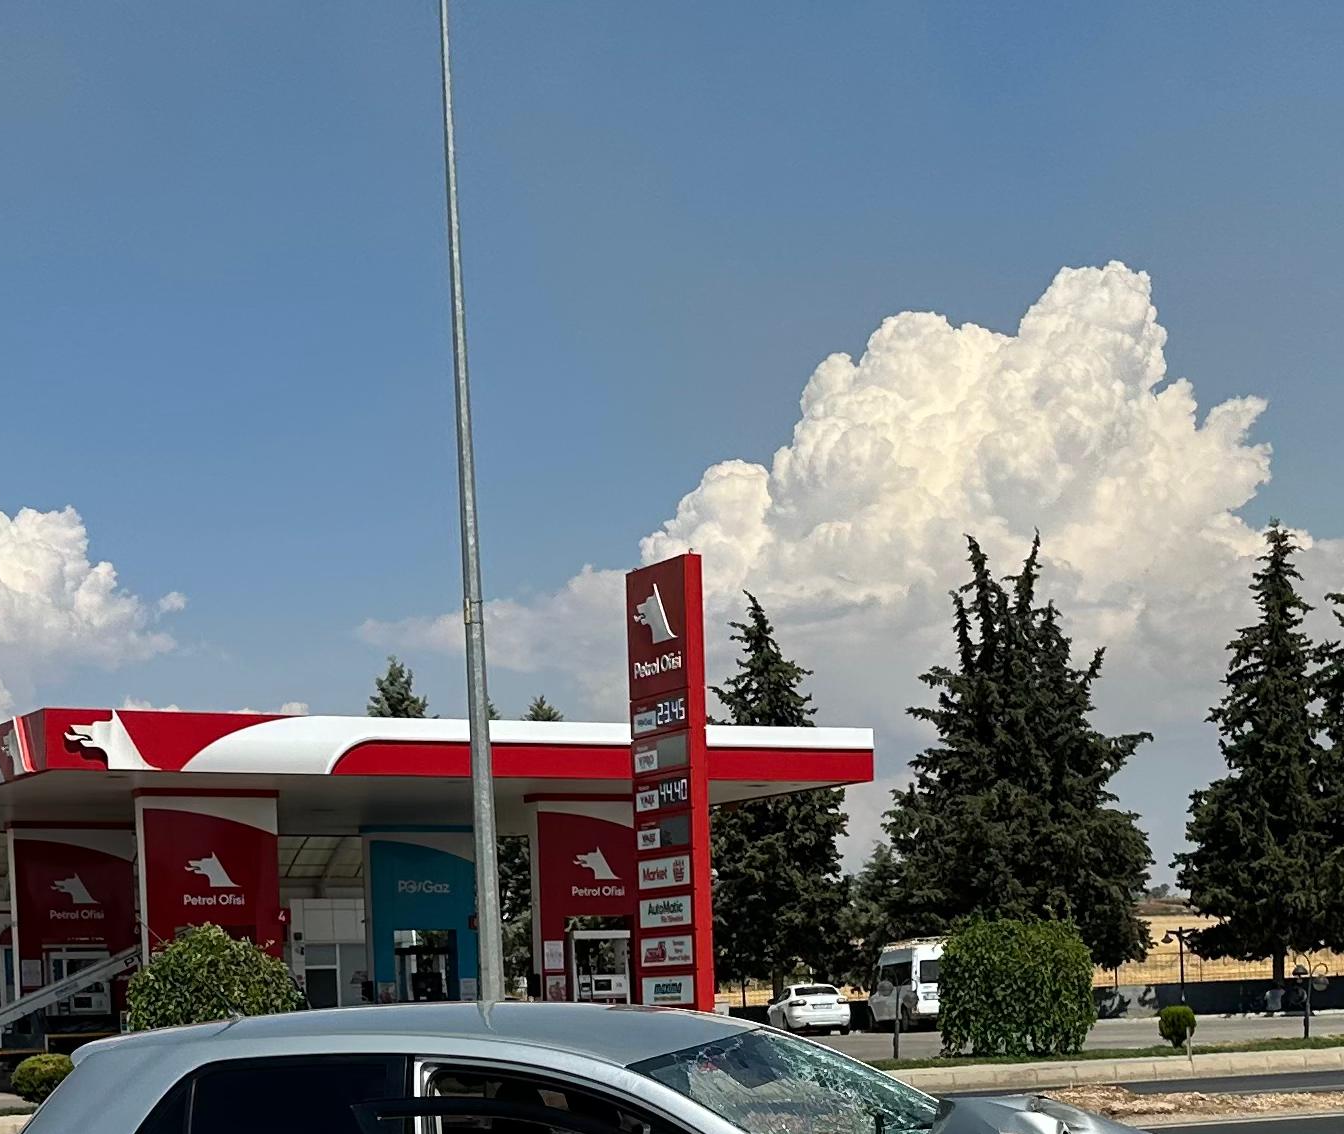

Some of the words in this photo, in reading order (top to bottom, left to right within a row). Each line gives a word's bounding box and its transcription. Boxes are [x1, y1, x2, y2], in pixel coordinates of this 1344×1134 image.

[634, 657, 659, 679] Petrol
[643, 866, 667, 881] Market
[571, 886, 600, 896] Petrol
[602, 886, 625, 896] Ofisi
[184, 894, 216, 905] Petrol
[219, 893, 245, 905] Ofisi
[49, 910, 79, 919] Petrol
[81, 910, 104, 919] Ofisi
